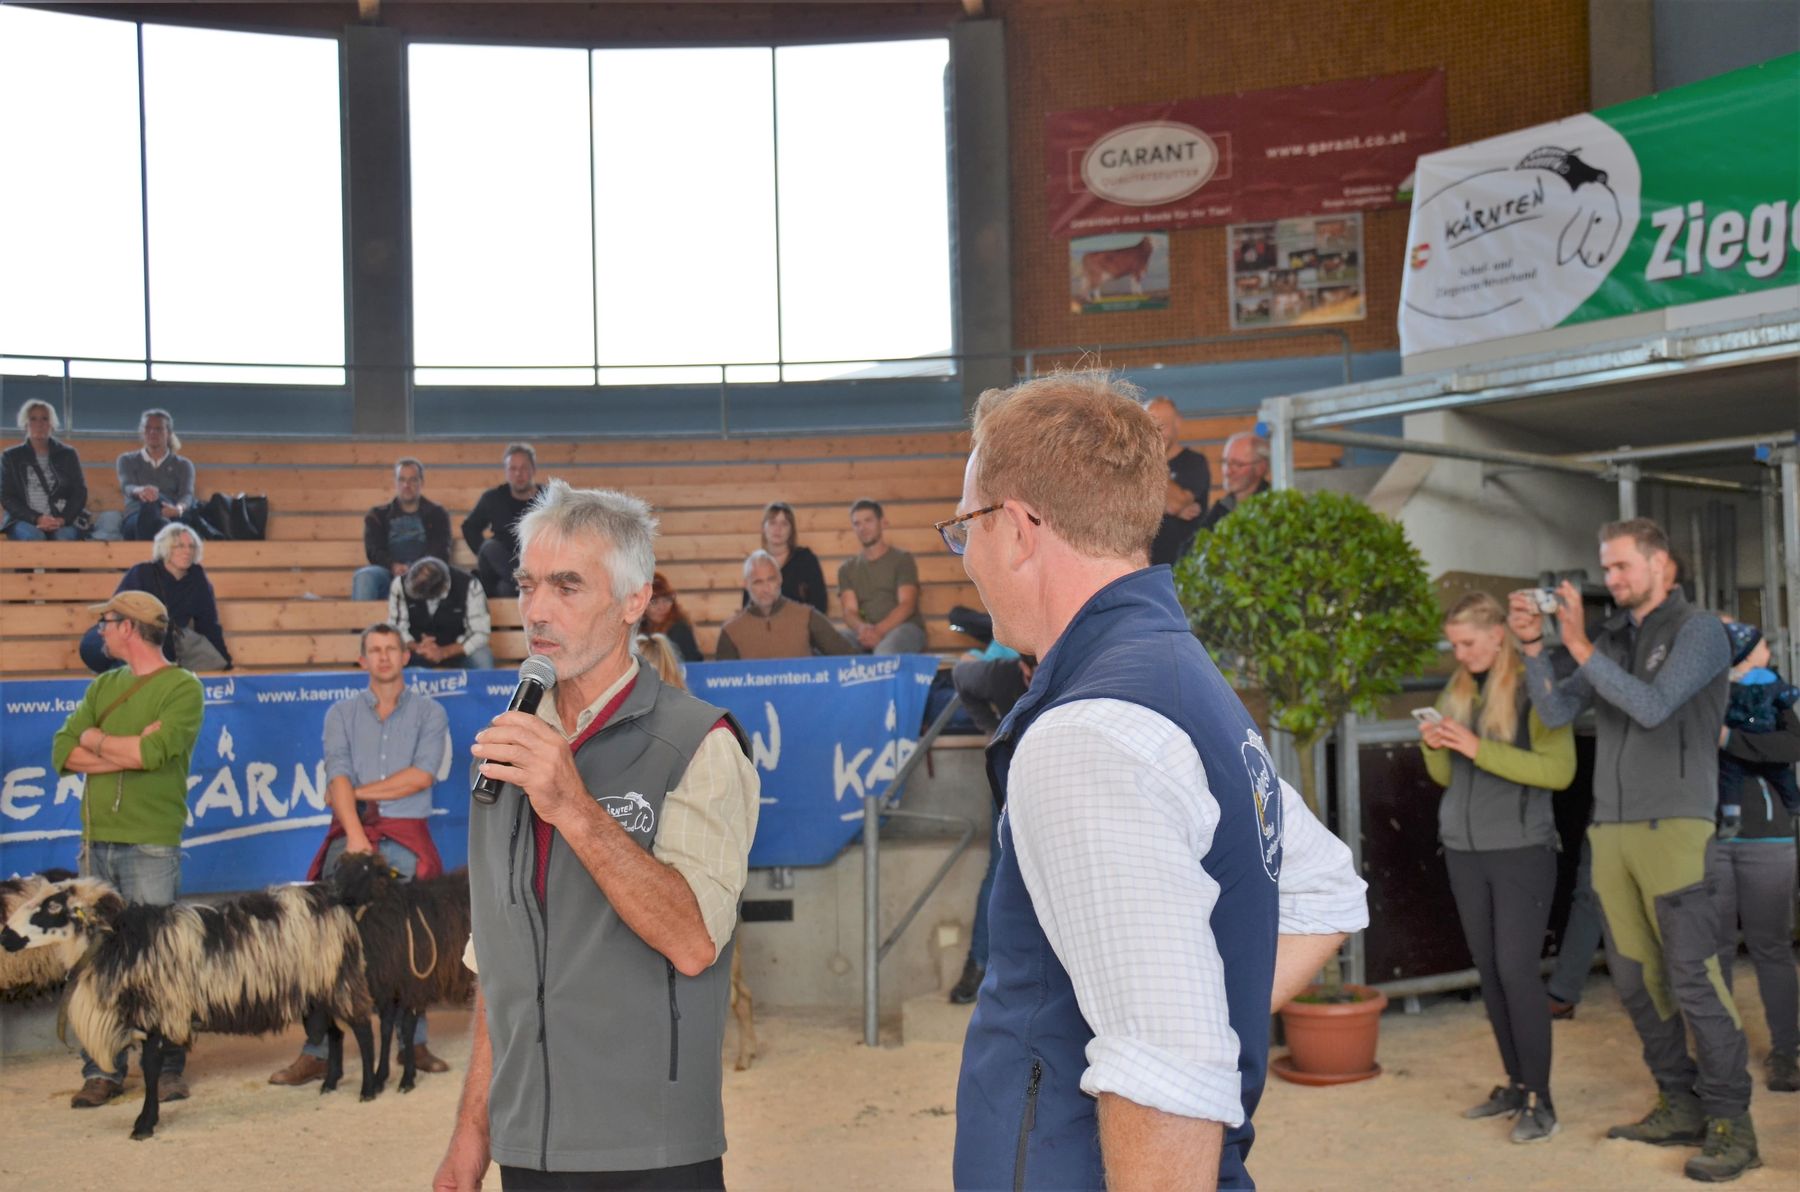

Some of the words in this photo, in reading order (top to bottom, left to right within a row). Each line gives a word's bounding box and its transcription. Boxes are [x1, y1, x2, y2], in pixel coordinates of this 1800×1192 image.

[1100, 141, 1198, 169] GARANT
[1265, 131, 1407, 158] www.garant.co.at
[1645, 200, 1800, 281] Zieg
[706, 670, 830, 688] www.kaernten.at
[257, 686, 367, 703] www.kaernte
